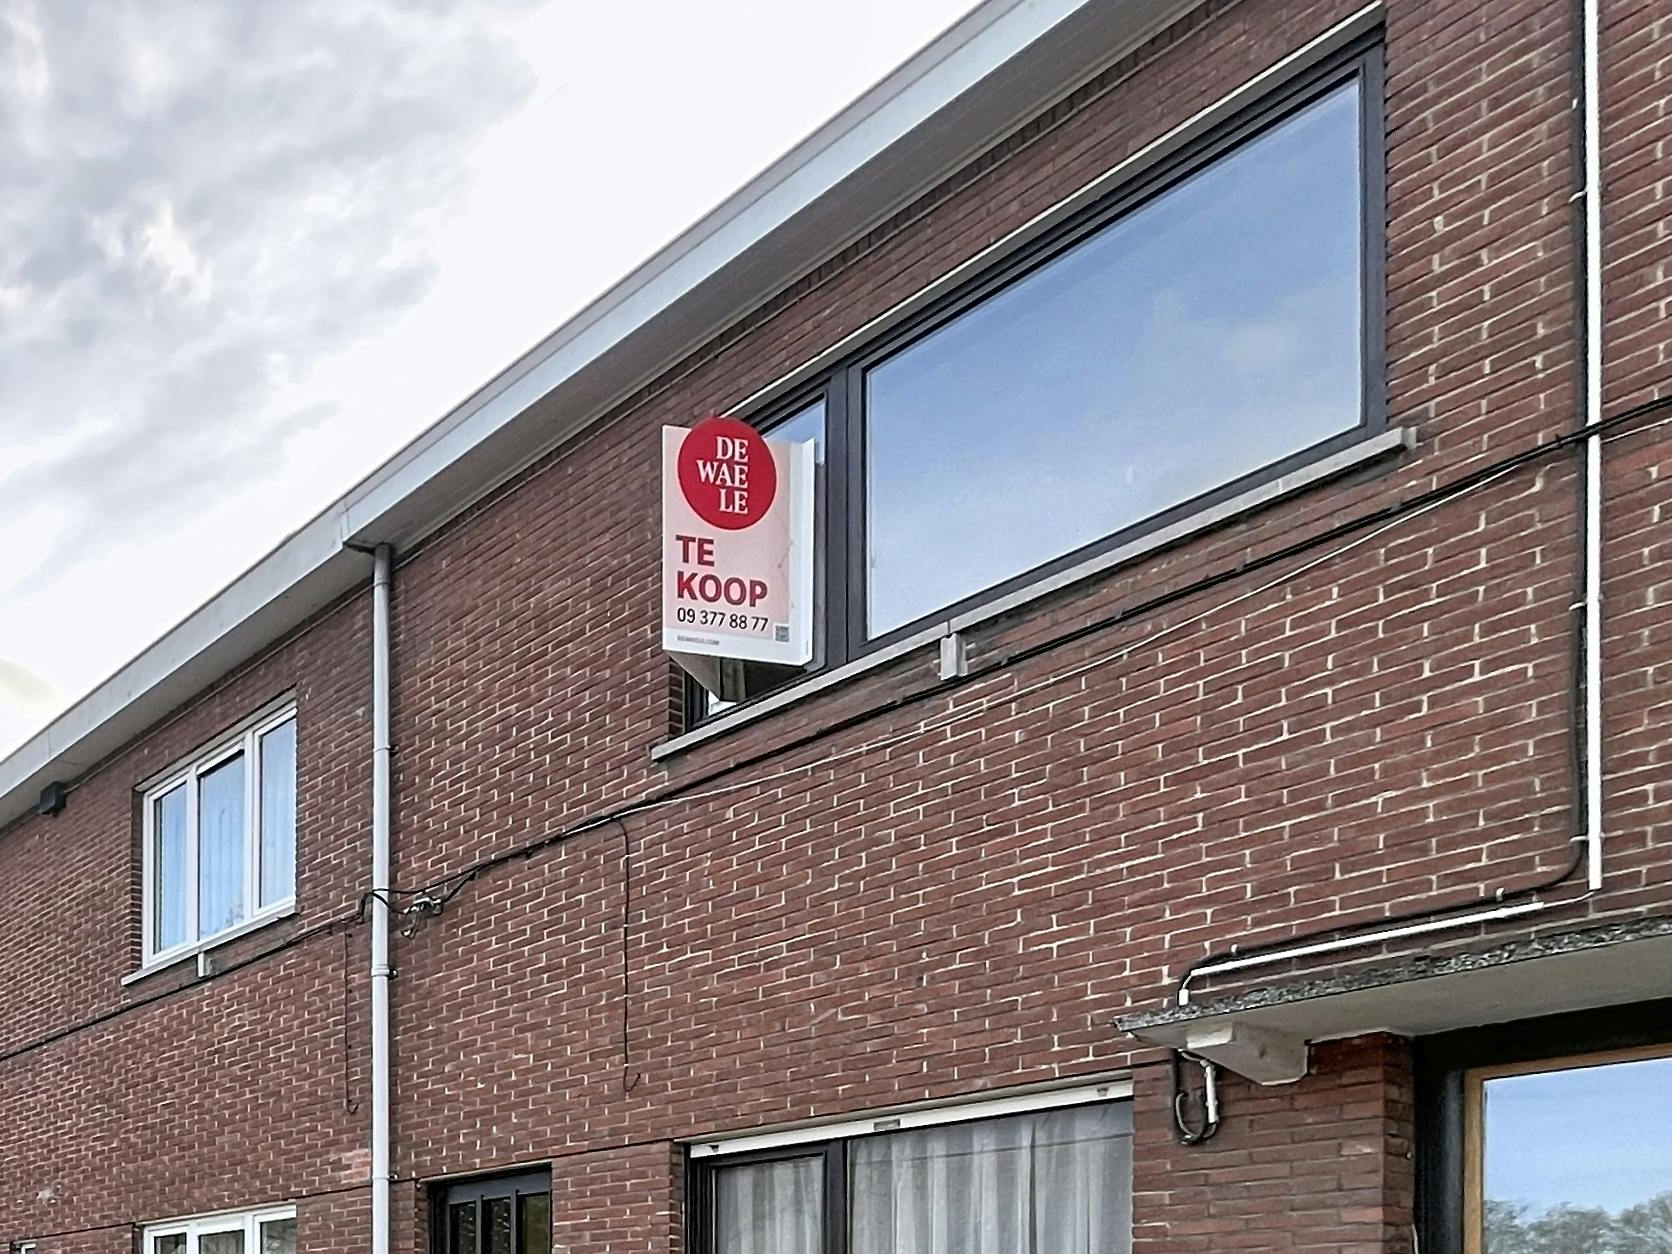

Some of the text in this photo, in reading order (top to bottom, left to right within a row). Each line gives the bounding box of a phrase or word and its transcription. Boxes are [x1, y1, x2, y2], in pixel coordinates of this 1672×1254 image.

[716, 436, 748, 462] DE
[696, 460, 748, 488] WAE
[719, 488, 748, 514] LE
[675, 534, 715, 566] TE
[676, 571, 768, 607] KOOP
[677, 607, 769, 632] 09 377 88 77
